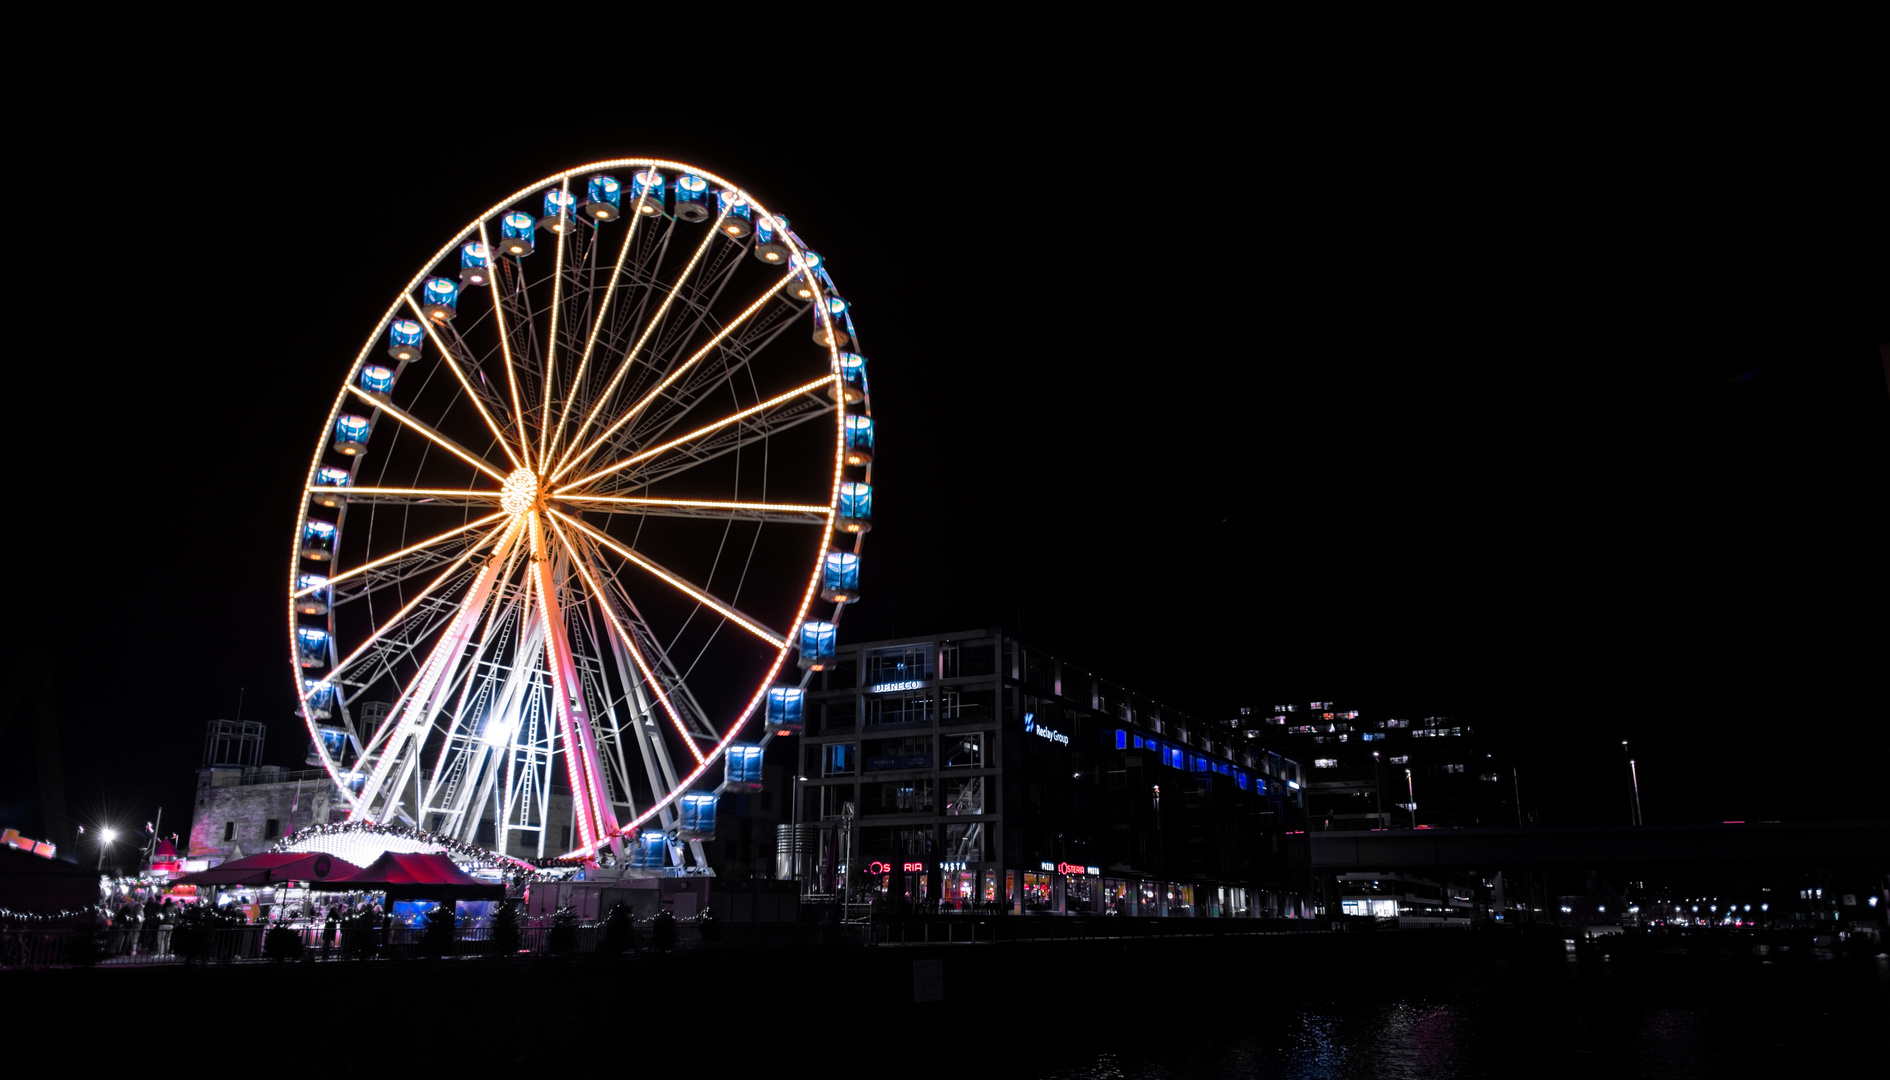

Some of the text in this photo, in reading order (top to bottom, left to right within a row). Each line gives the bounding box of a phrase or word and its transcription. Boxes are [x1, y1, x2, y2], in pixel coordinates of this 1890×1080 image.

[1036, 724, 1069, 747] Reclay Group
[939, 862, 967, 872] PASTA
